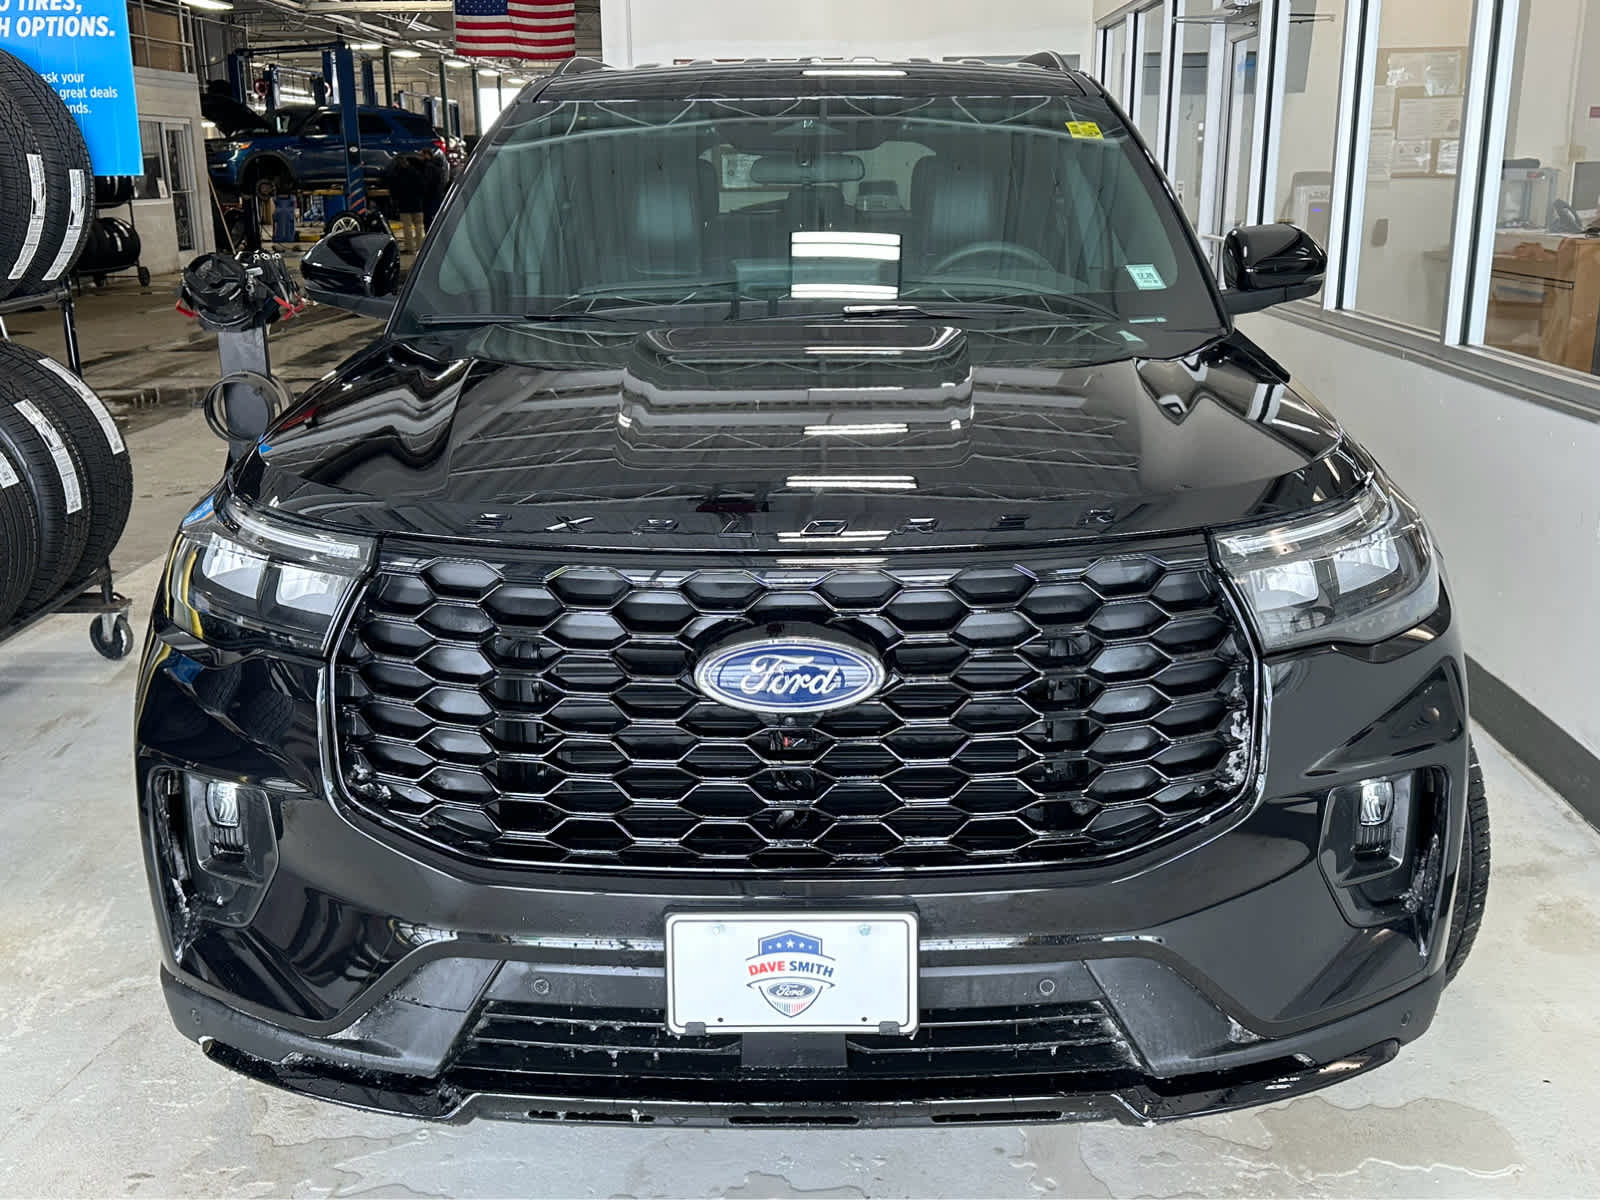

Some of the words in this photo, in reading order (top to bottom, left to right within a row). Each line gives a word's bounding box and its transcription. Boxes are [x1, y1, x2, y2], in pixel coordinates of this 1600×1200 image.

[16, 16, 116, 38] OPTIONS.
[61, 73, 85, 86] your
[59, 87, 88, 101] great
[90, 86, 118, 99] deals
[66, 100, 92, 114] nds.
[741, 654, 841, 695] Ford
[748, 960, 786, 976] DAVE
[789, 960, 834, 978] SMITH
